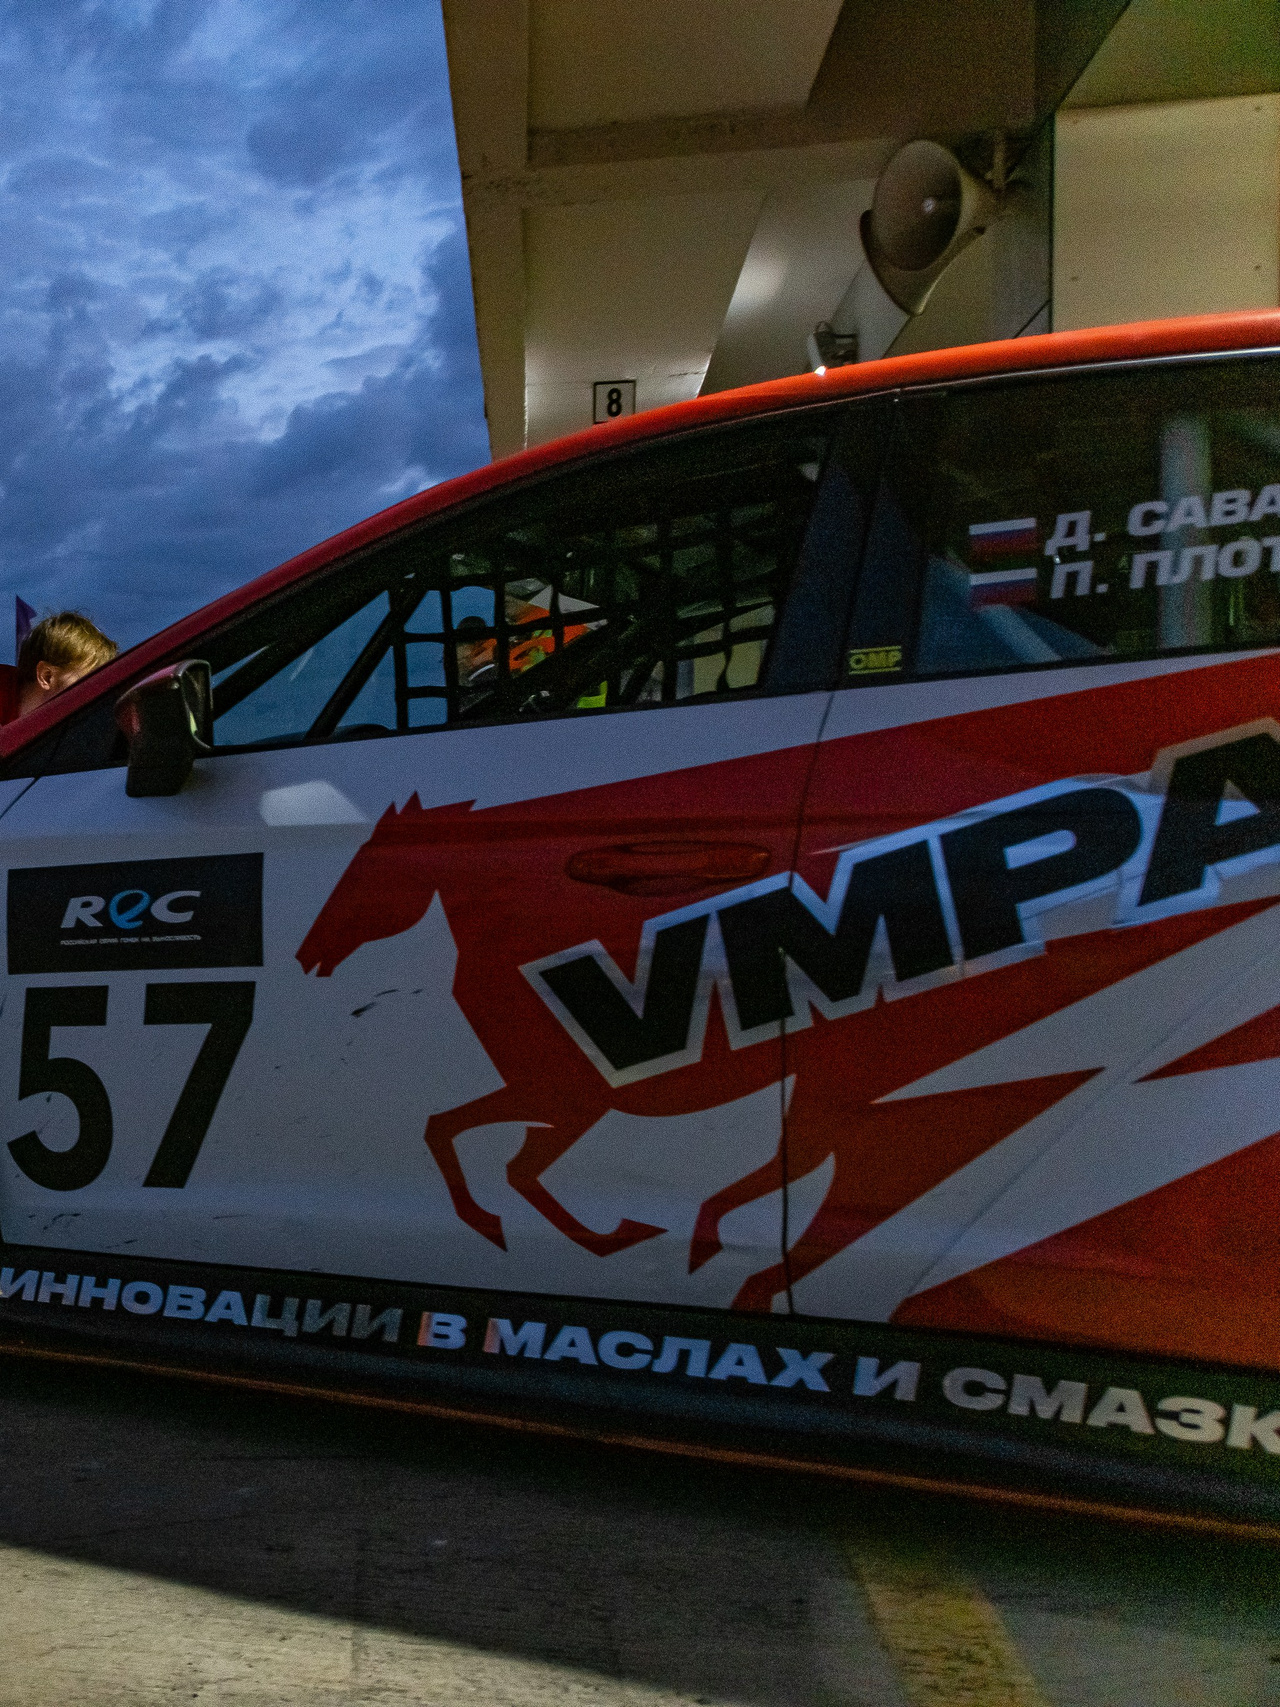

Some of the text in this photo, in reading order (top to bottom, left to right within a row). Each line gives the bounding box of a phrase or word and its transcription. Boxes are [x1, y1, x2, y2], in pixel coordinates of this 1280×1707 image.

[608, 388, 622, 417] 8
[1044, 483, 1280, 556] Д. САВА
[1050, 561, 1108, 599] П.
[849, 651, 902, 669] OMP
[534, 728, 1280, 1074] VMPA
[7, 981, 256, 1191] 57
[417, 1311, 467, 1350] В
[483, 1317, 835, 1392] МАСЛАХ
[854, 1356, 921, 1401] И
[942, 1367, 1280, 1455] СМАЗК
